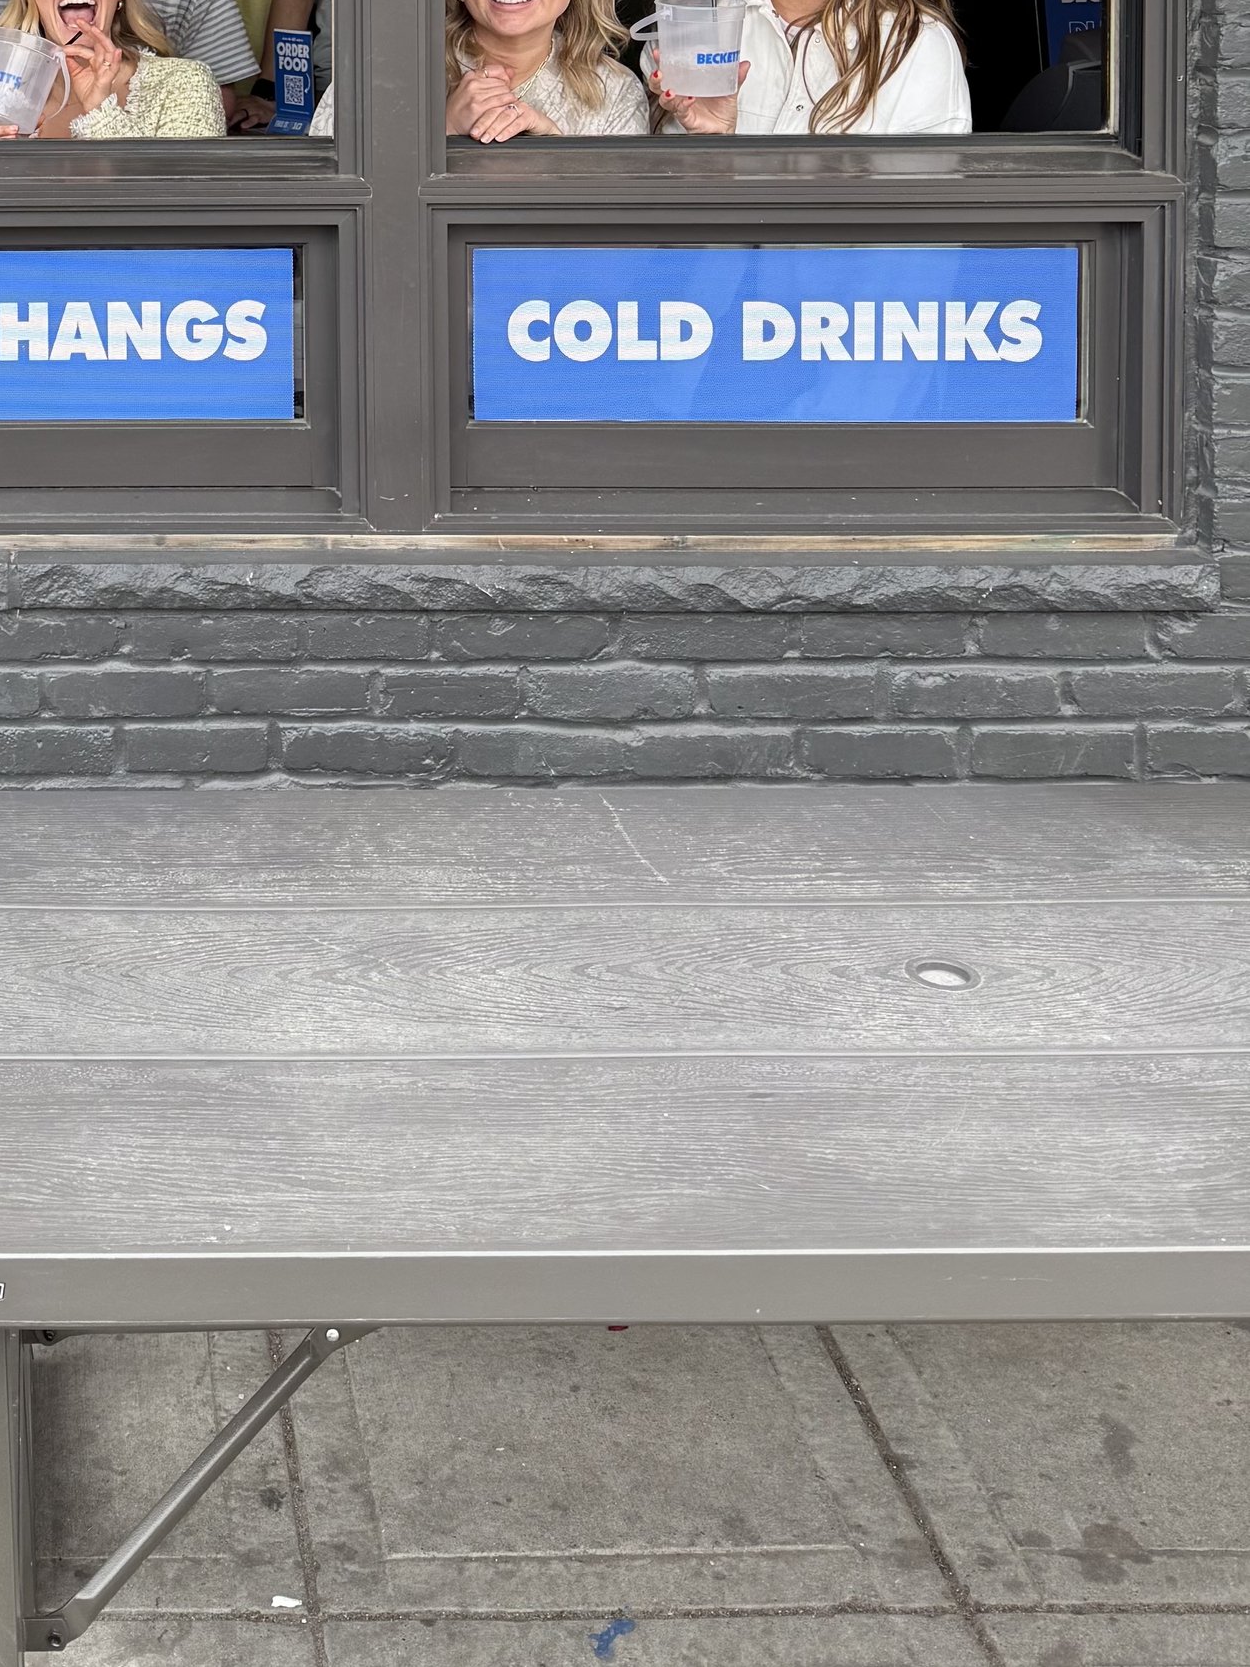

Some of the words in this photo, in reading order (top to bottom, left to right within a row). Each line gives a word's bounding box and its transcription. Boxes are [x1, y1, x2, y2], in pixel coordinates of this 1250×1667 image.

[276, 42, 310, 59] ORDER
[278, 56, 308, 72] FOOD
[507, 300, 714, 363] COLD
[741, 300, 1043, 363] DRINKS
